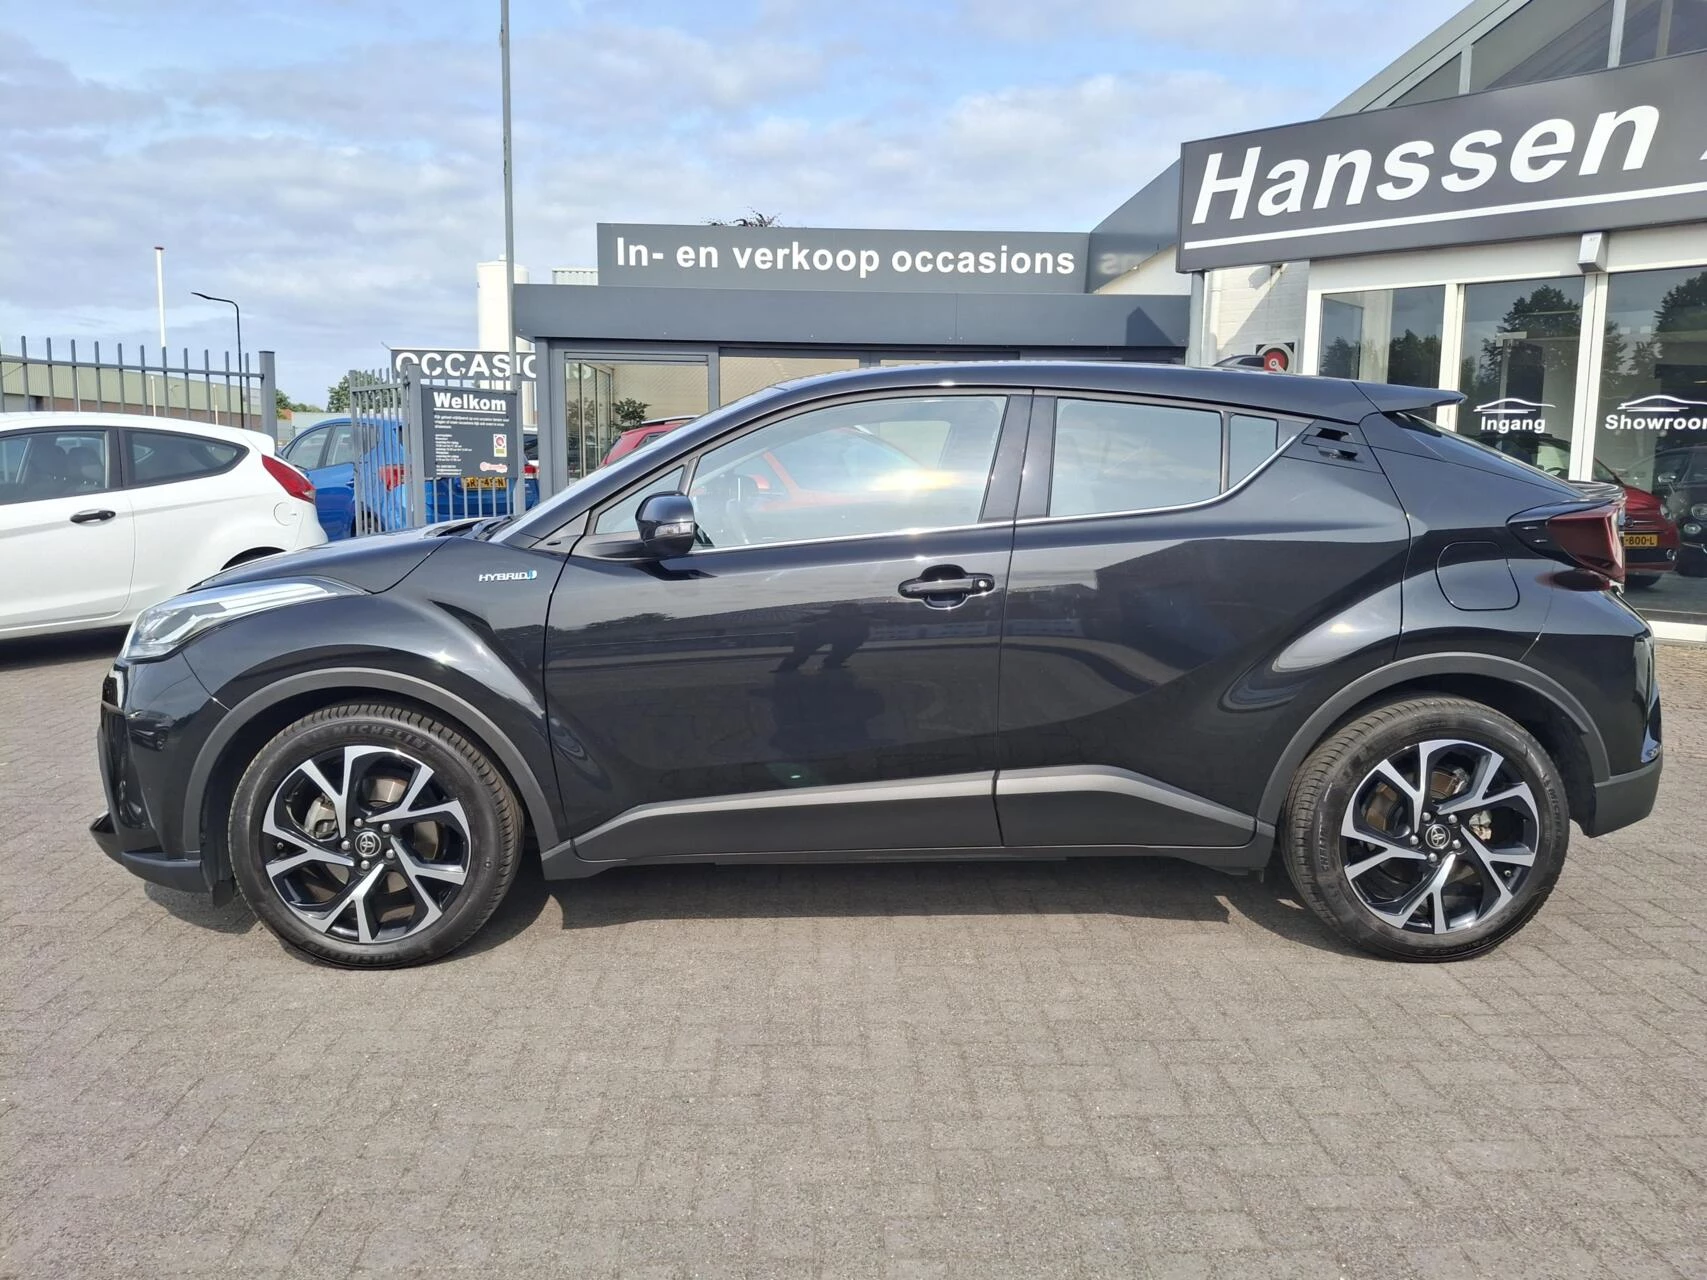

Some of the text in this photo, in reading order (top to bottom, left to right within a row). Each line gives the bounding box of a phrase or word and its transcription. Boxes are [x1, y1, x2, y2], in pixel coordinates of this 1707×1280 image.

[1191, 104, 1660, 225] Hanssen
[616, 237, 664, 267] In-
[676, 245, 719, 268] en
[732, 240, 881, 280] verkoop
[890, 245, 1076, 276] occasions
[433, 391, 506, 411] Welkom
[1480, 416, 1546, 434] Ingang
[1604, 414, 1707, 430] Showroo
[1624, 536, 1655, 546] -800-L
[478, 571, 529, 582] HYBRID
[332, 724, 428, 750] MICHELIN
